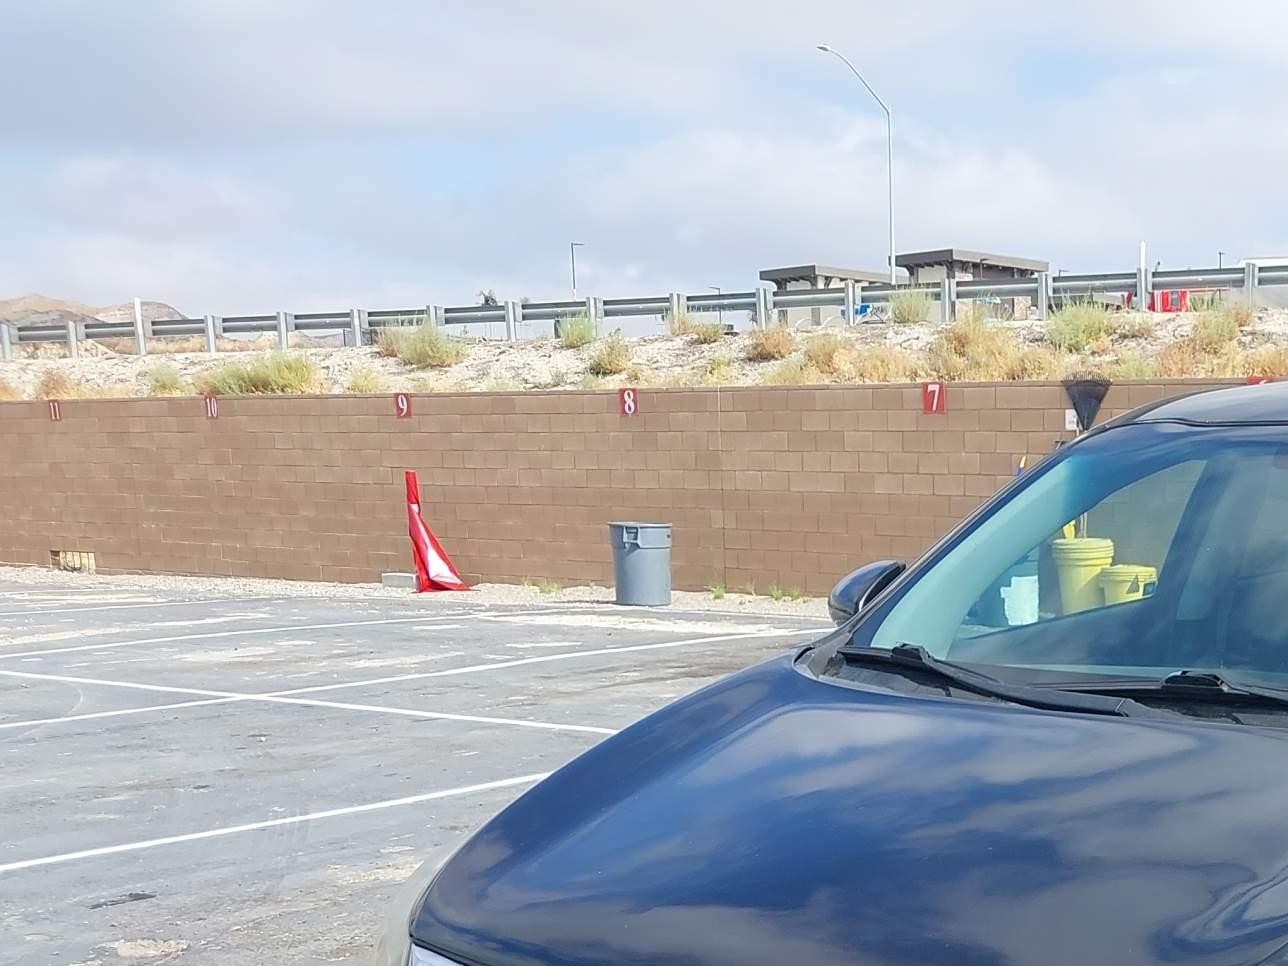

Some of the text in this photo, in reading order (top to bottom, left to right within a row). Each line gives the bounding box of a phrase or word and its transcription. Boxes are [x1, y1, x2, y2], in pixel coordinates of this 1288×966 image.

[206, 397, 218, 417] 10
[398, 394, 408, 417] 9
[623, 390, 635, 414] 8
[927, 384, 940, 411] 7
